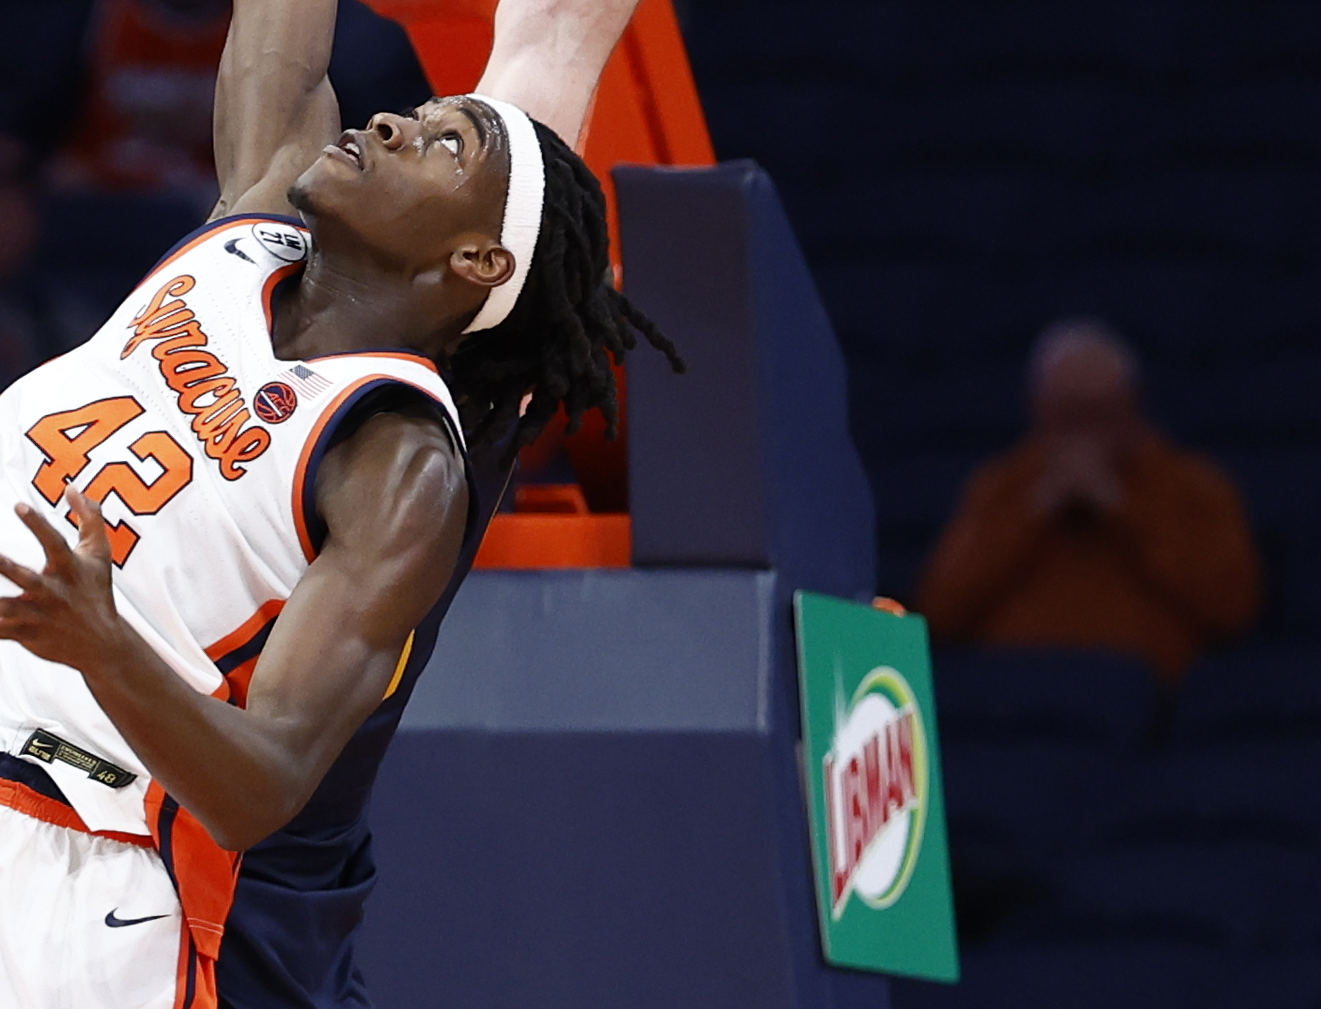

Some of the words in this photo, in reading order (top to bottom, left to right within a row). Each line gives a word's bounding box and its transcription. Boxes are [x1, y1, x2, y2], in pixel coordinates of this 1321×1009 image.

[119, 274, 272, 481] Syracuse
[25, 395, 194, 569] 42
[97, 769, 117, 784] 48
[823, 705, 917, 917] LIBMAN
